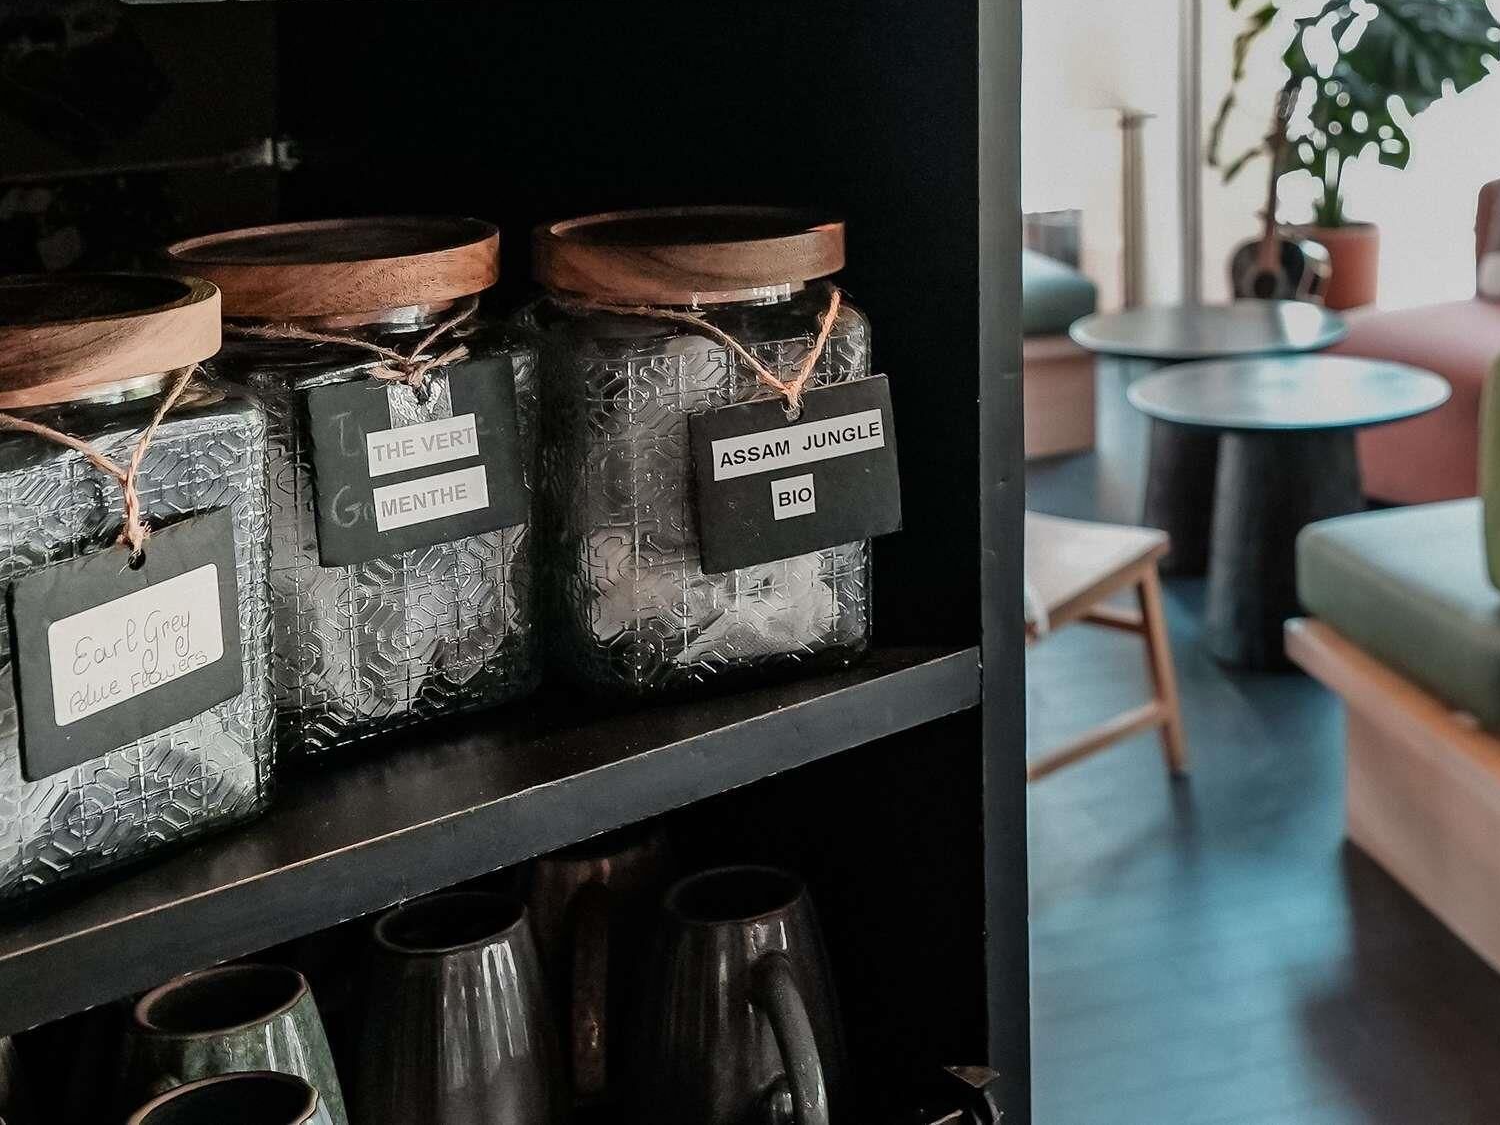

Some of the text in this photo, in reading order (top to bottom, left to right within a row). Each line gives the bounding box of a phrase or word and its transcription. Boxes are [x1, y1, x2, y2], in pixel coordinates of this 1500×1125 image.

[372, 426, 475, 461] THE VERT
[720, 421, 881, 468] ASSAM JUNGLE
[381, 483, 467, 517] MENTHE
[778, 487, 812, 507] BIO
[73, 610, 191, 675] Earl Grey
